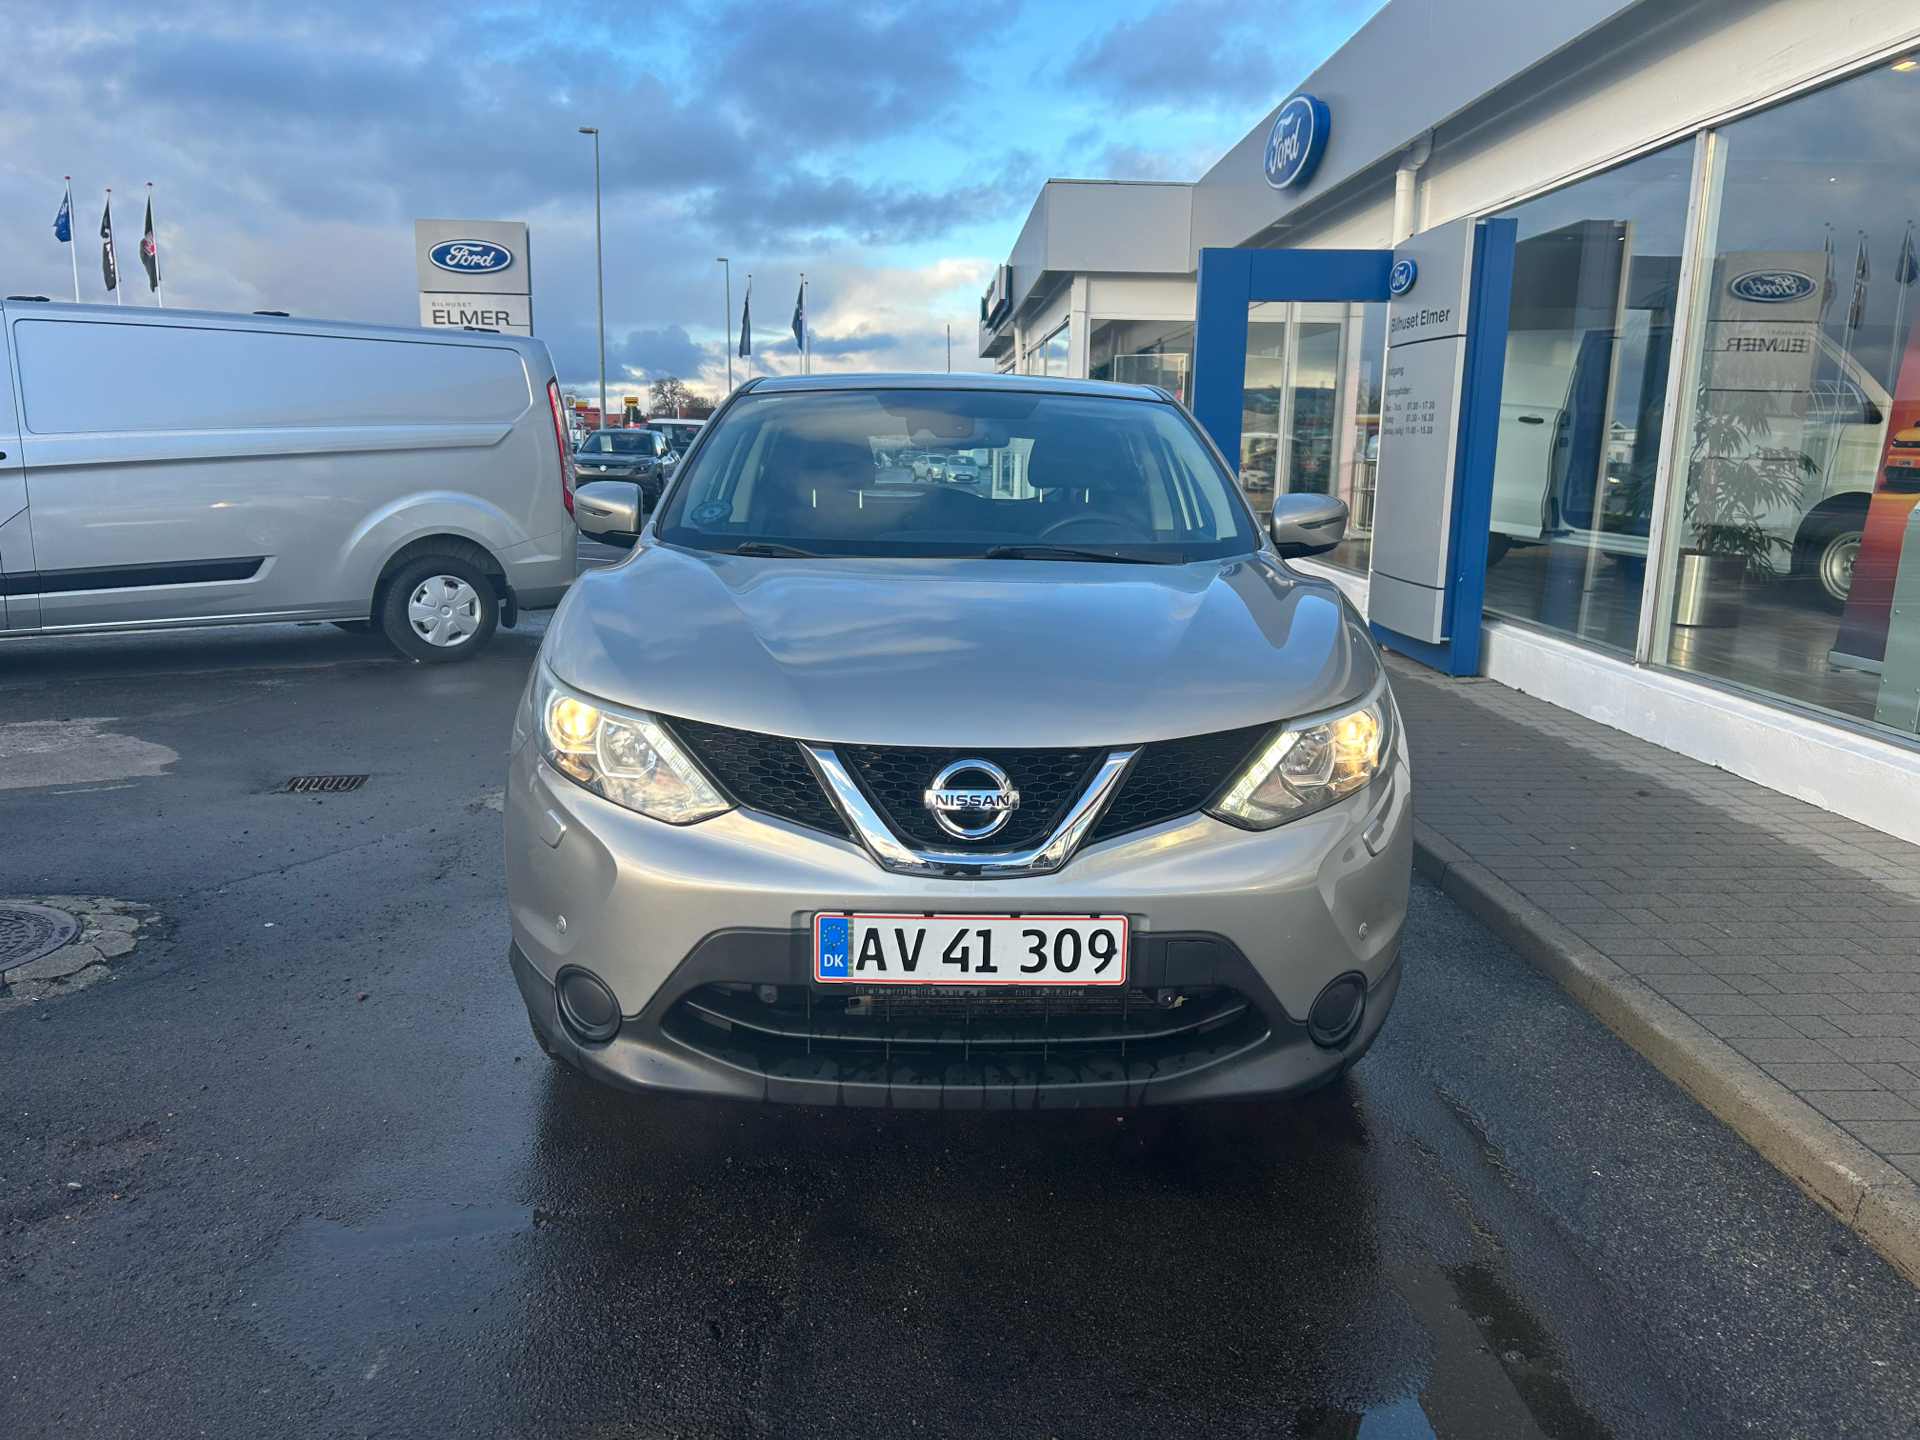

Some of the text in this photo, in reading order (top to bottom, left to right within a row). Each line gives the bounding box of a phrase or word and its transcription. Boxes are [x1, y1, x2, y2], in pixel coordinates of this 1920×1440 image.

[1269, 112, 1302, 175] Ford
[446, 244, 496, 266] Ford
[432, 309, 511, 326] ELMER
[1391, 308, 1451, 333] Bilhuset Elmer
[1422, 401, 1435, 410] 17.30
[1421, 413, 1434, 422] 16.30
[1420, 426, 1433, 435] 15.00
[935, 793, 1011, 808] NISSAN
[855, 927, 1118, 974] AV 41 309
[823, 953, 845, 968] DK
